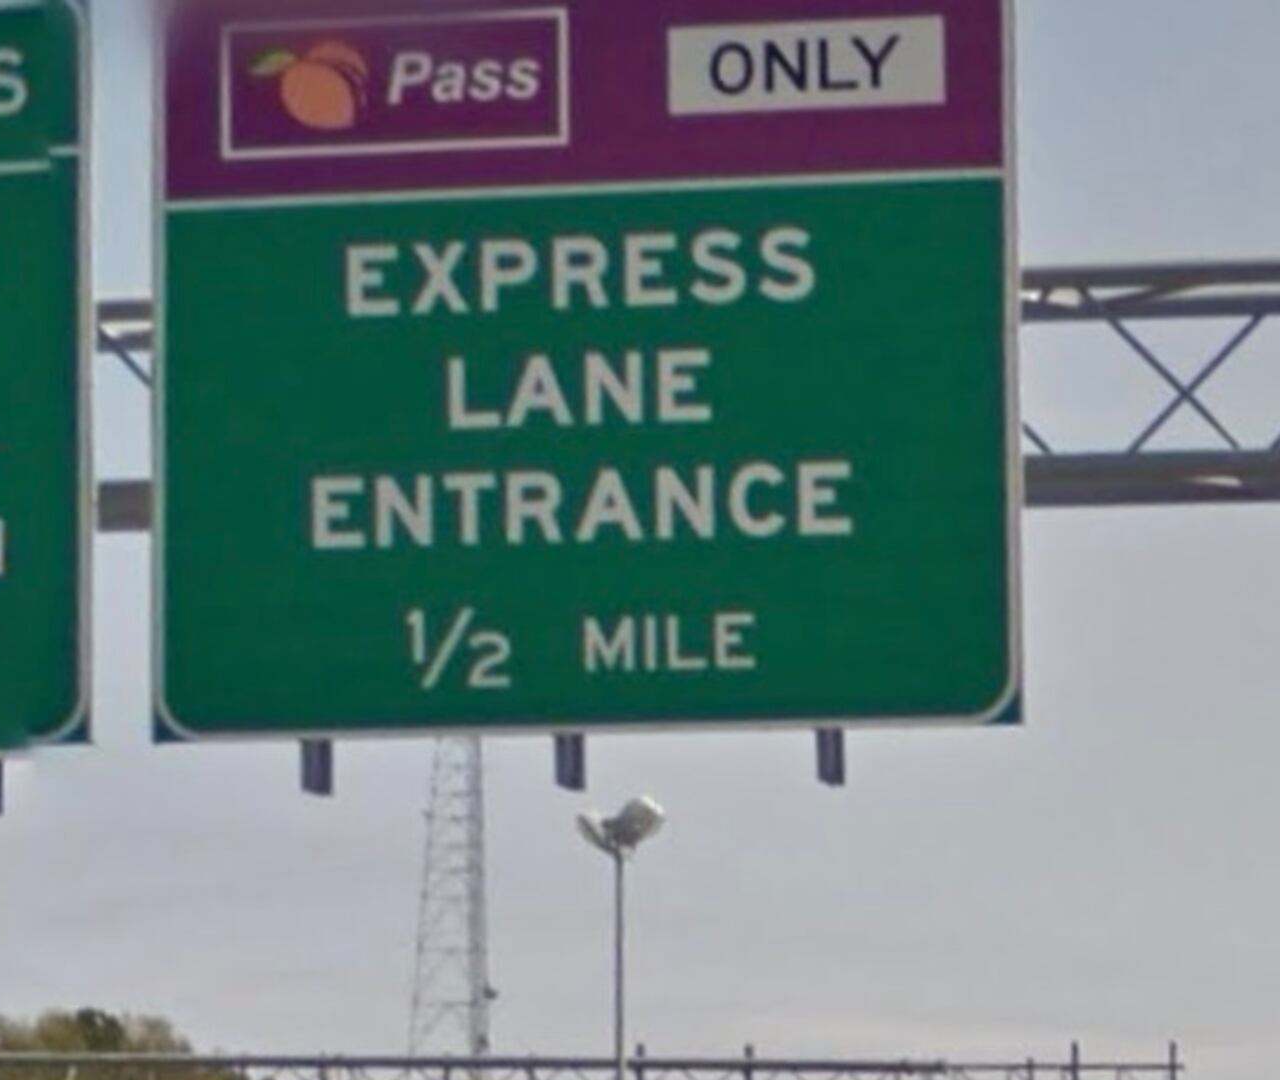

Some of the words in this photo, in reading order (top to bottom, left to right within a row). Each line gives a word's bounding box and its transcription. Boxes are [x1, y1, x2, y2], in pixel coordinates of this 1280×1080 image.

[387, 50, 542, 108] Pass
[709, 34, 900, 94] ONLY
[344, 226, 817, 319] EXPRESS
[446, 349, 712, 432] LANE
[310, 460, 855, 551] ENTRANCE
[581, 612, 758, 672] MILE
